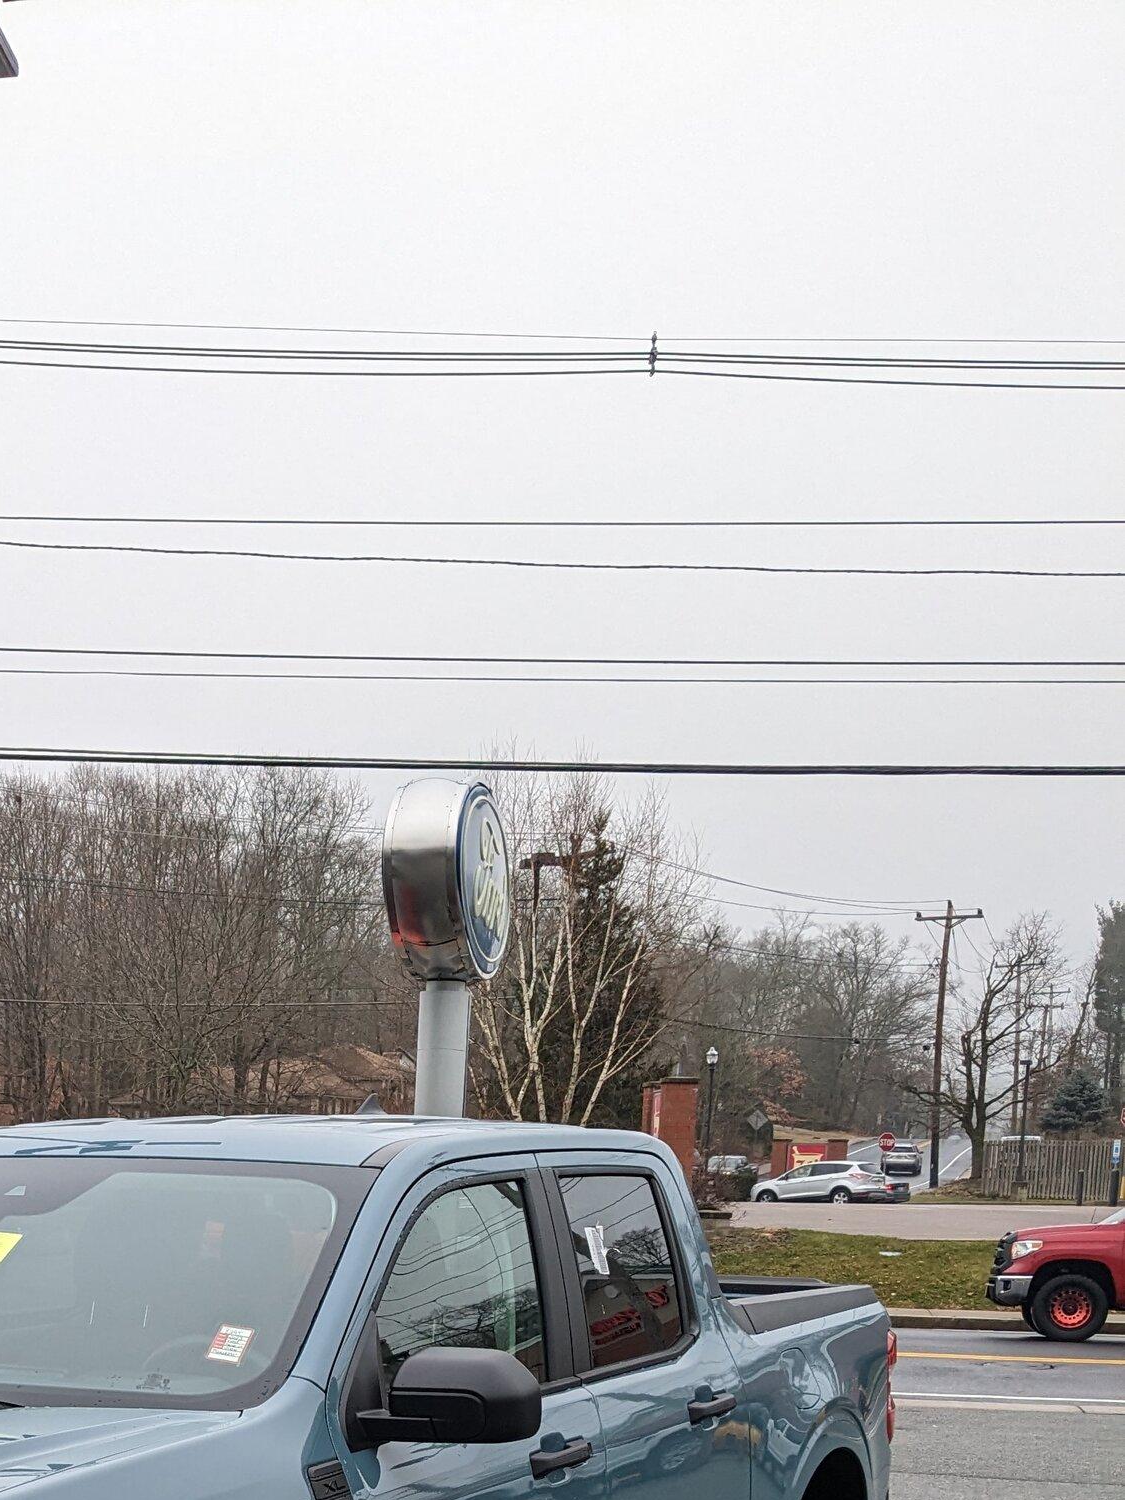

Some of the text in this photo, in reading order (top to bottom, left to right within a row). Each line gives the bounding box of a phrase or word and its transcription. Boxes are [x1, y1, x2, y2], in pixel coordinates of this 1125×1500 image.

[472, 816, 507, 942] Ford
[879, 1138, 895, 1147] STOP
[322, 1480, 346, 1495] XL
